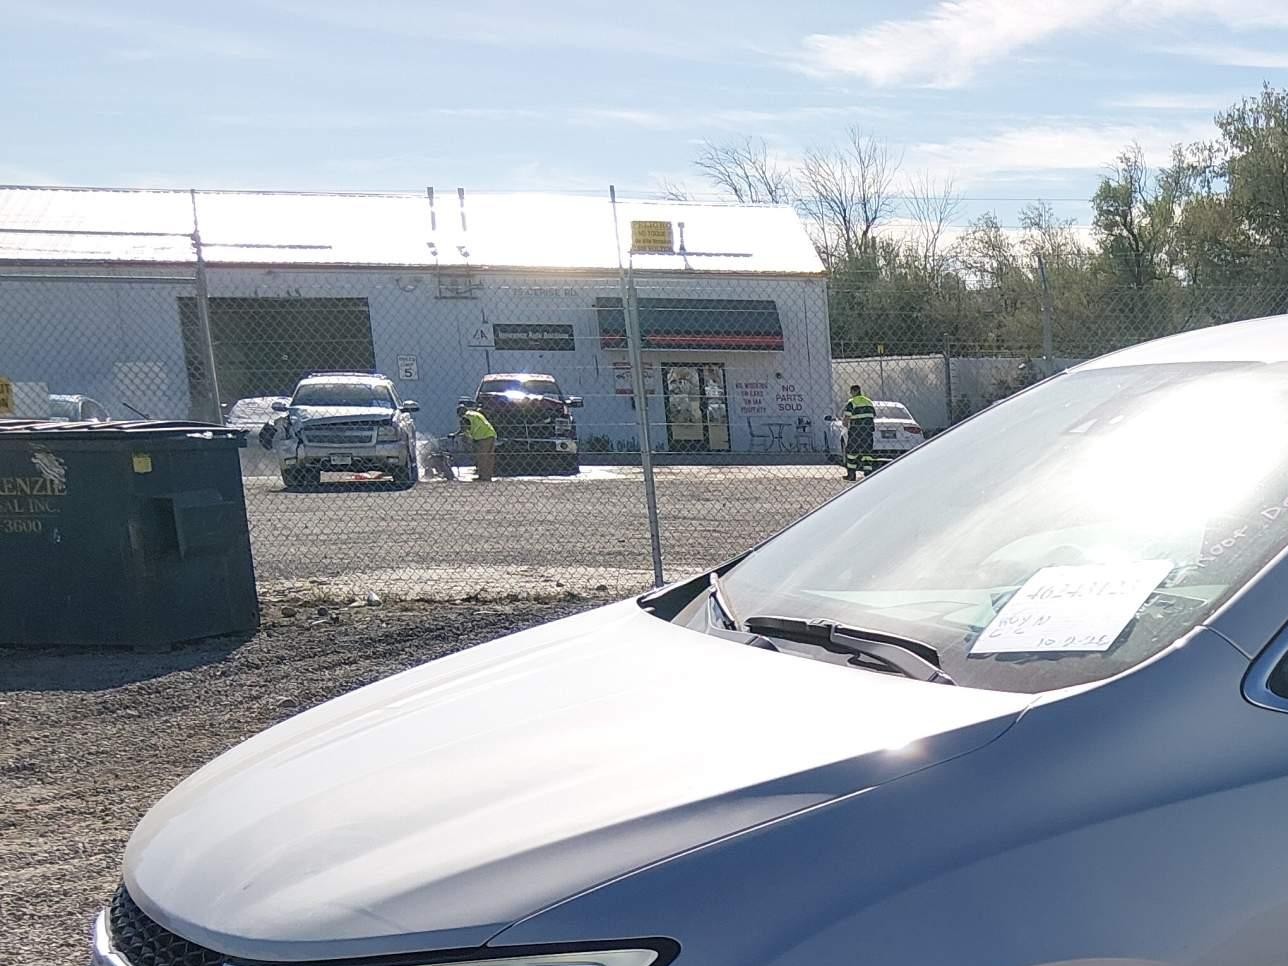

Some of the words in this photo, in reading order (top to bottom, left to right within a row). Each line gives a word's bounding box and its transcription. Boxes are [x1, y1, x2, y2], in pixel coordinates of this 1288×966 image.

[404, 368, 412, 377] 5
[776, 394, 803, 402] PARTS
[778, 403, 802, 411] SOLD
[28, 498, 60, 513] INC.
